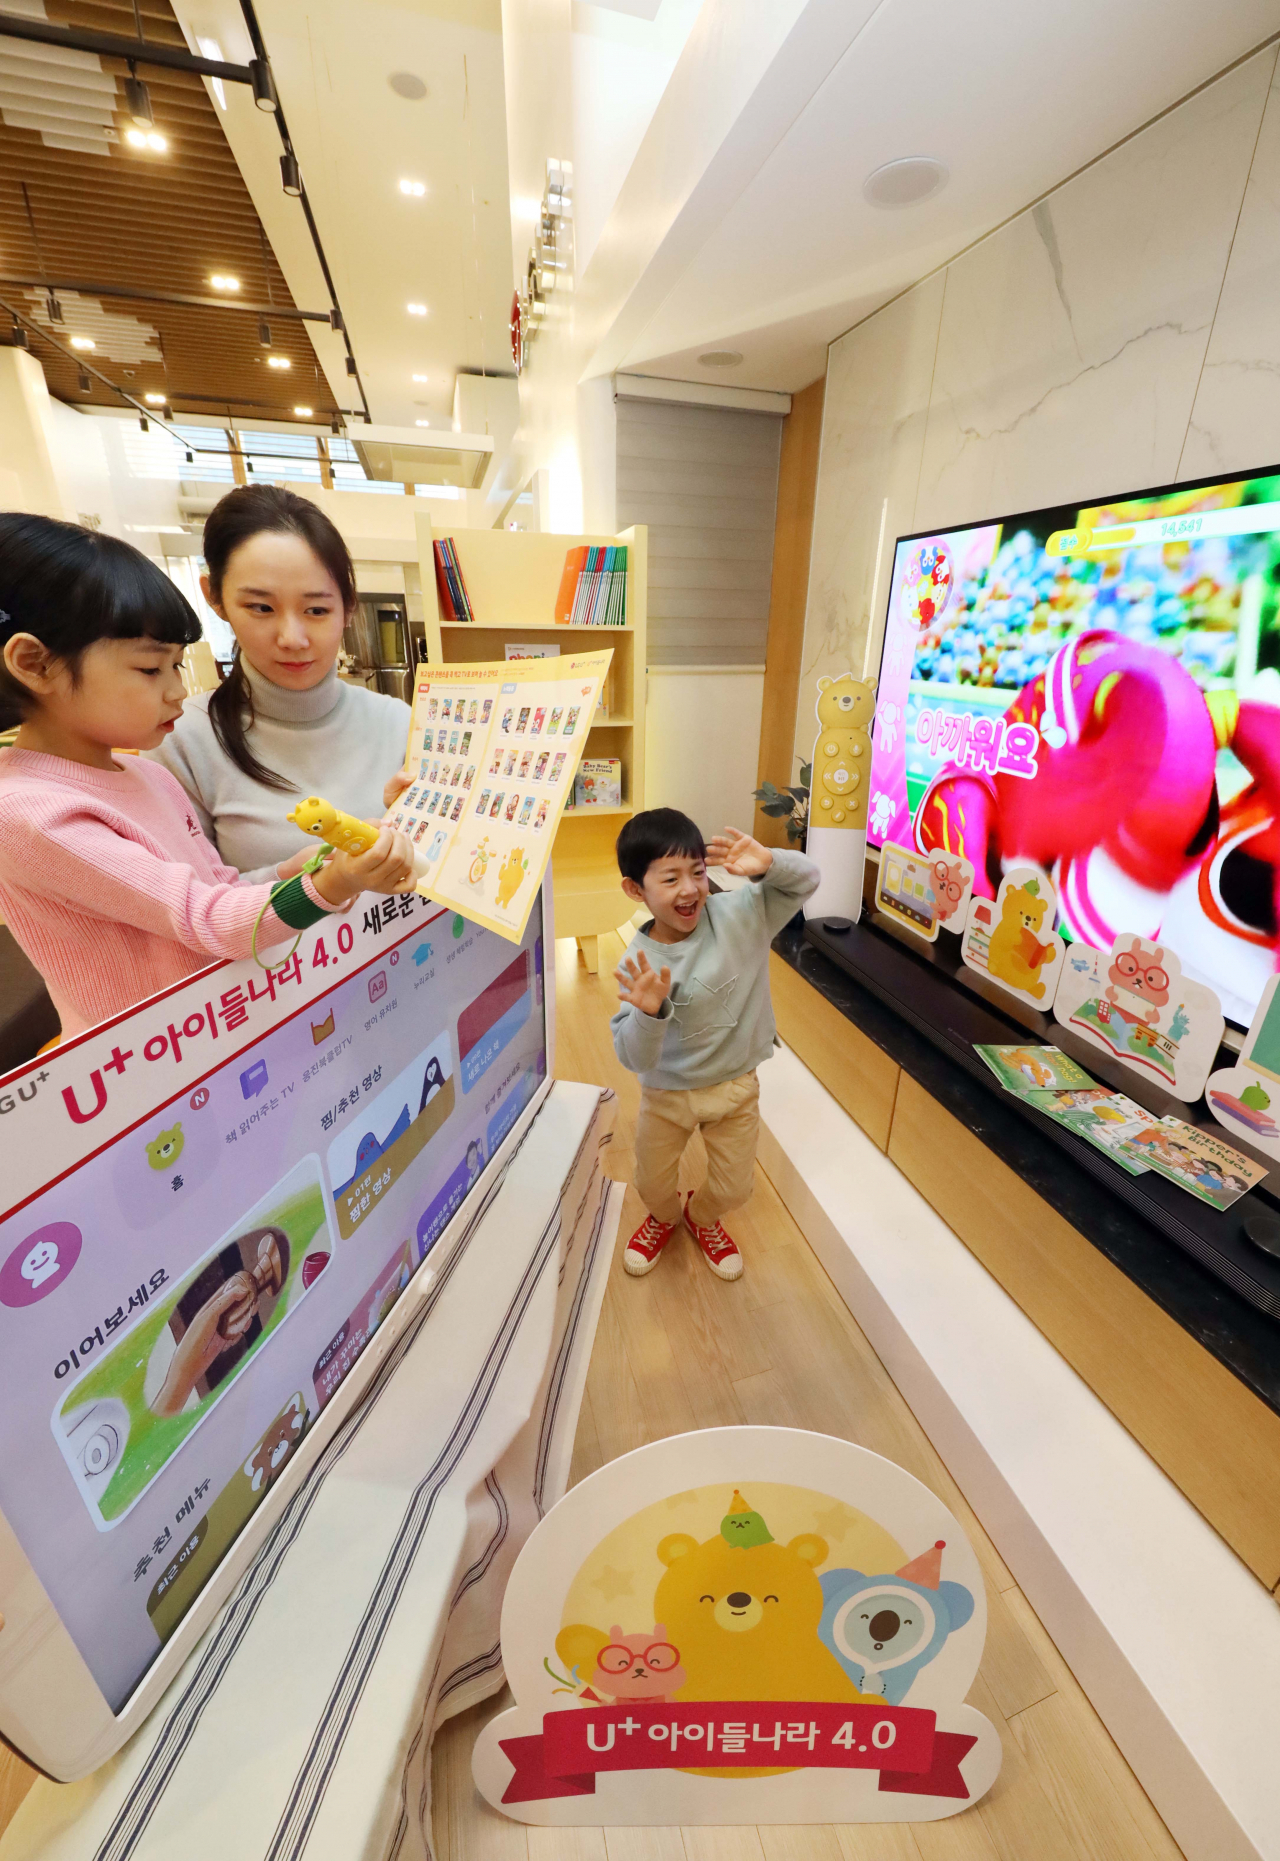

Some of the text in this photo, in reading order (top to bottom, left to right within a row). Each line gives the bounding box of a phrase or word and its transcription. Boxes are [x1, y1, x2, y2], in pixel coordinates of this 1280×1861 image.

[1161, 518, 1203, 537] 14,541
[915, 709, 1039, 778] 아까워요
[372, 979, 385, 996] Aa
[413, 968, 435, 990] 누리교실
[61, 893, 415, 1124] U+ 아이들나라 4.0 새로운
[364, 998, 398, 1031] 영어 유치원
[302, 1035, 353, 1083] 웅진북클럽TV
[1055, 1054, 1077, 1072] What
[225, 1082, 295, 1144] 책 읽어주는 TV
[320, 1064, 383, 1131] 찜/추천 영상
[1134, 1110, 1154, 1124] Sp
[1183, 1125, 1247, 1164] Kipper's
[1188, 1135, 1253, 1178] Birthday
[171, 1174, 185, 1192] 홈
[350, 1167, 392, 1223] 찜한 영상
[53, 1267, 170, 1380] 이어보세요
[322, 1361, 339, 1385] 내가
[133, 1478, 211, 1582] 추천 메뉴
[179, 1535, 199, 1562] 이용
[586, 1716, 898, 1753] U+ 아이들나라 4.0
